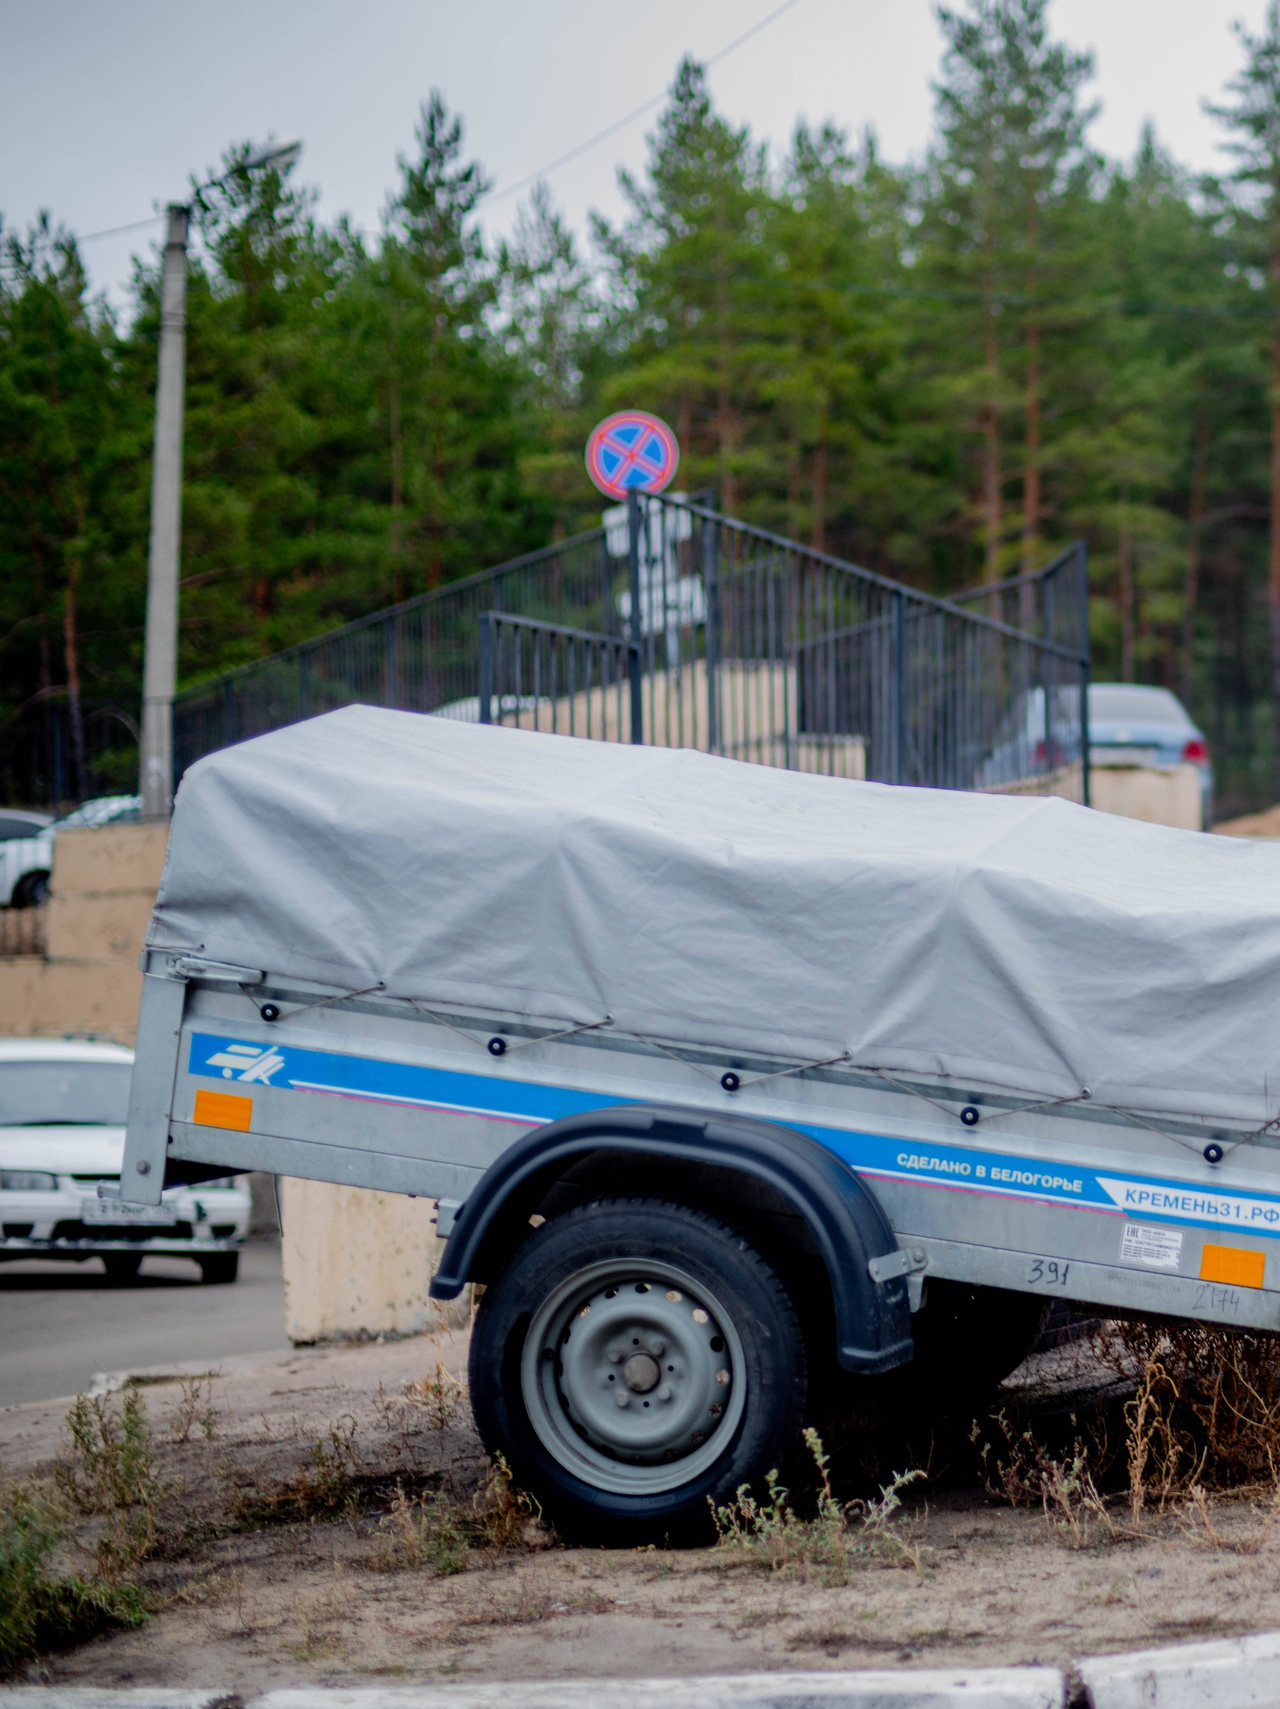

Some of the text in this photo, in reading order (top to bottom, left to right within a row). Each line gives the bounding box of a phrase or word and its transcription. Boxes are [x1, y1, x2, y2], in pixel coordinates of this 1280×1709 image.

[897, 1153, 1083, 1193] СДЕЛАНО В БЕЛОГОРЬЕ
[1126, 1190, 1280, 1223] КРЕМЕНЬ31.РФ
[1028, 1260, 1069, 1285] 391
[1192, 1284, 1239, 1313] 2174
